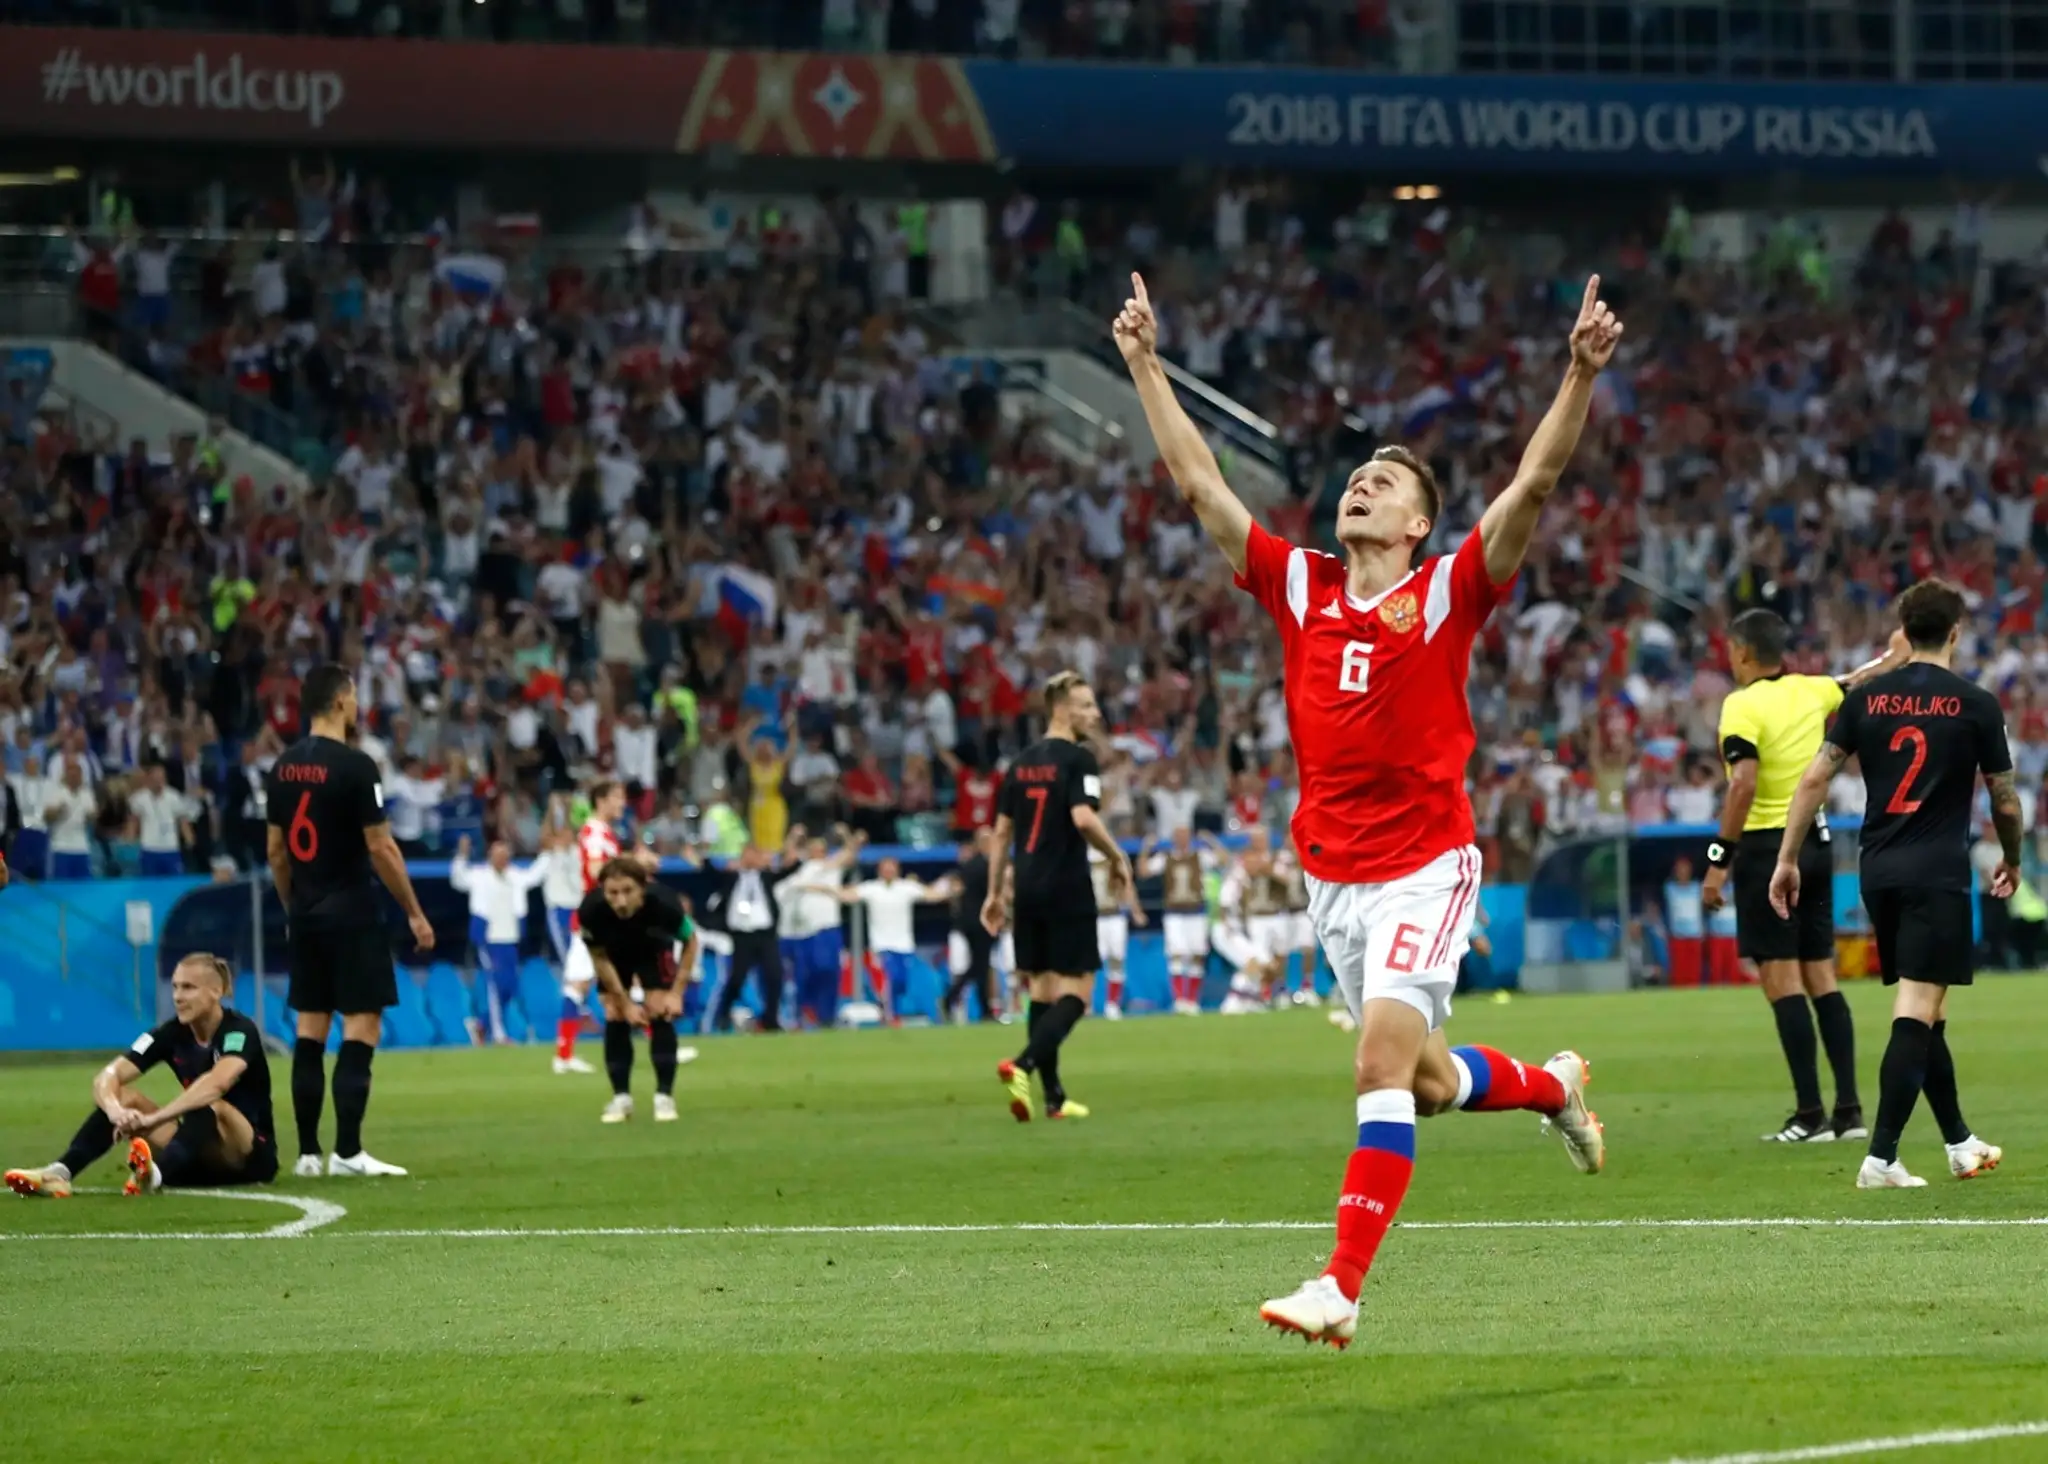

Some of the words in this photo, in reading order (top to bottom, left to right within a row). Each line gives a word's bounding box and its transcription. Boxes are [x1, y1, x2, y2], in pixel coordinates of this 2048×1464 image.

[41, 47, 344, 128] #worldcup
[1228, 92, 1340, 146] 2018
[1350, 94, 1452, 147] FIFA
[1459, 97, 1638, 151] WORLD
[1643, 102, 1746, 154] CUP
[1755, 105, 1937, 158] RUSSIA
[1339, 640, 1374, 693] 6
[1867, 694, 1961, 716] VRSALJKO
[279, 763, 327, 784] LOVREN
[1886, 725, 1927, 813] 2
[289, 790, 318, 862] 6
[1025, 787, 1048, 854] 7
[1385, 923, 1424, 973] 6
